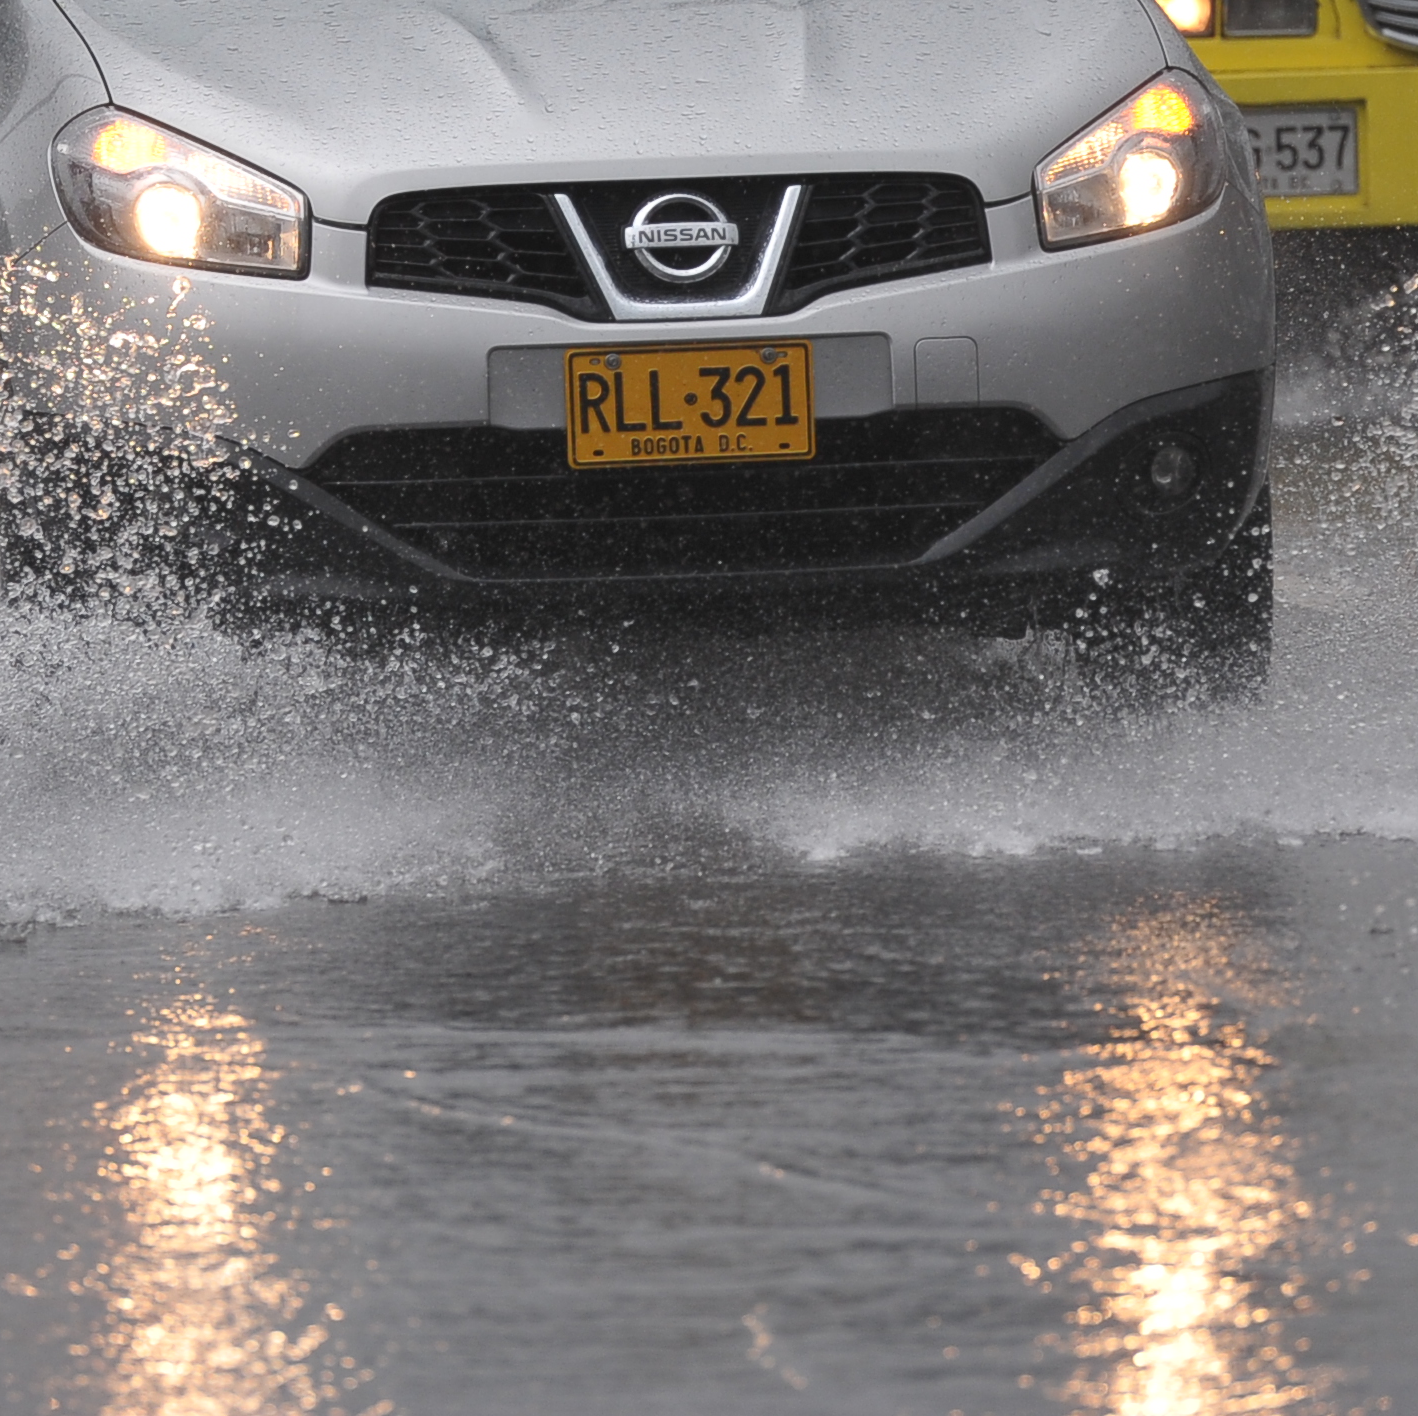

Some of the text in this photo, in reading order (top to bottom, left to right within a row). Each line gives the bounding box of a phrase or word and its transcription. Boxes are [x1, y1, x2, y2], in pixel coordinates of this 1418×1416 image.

[637, 226, 728, 244] NISSAN
[630, 432, 754, 456] BOGOTA D.C.
